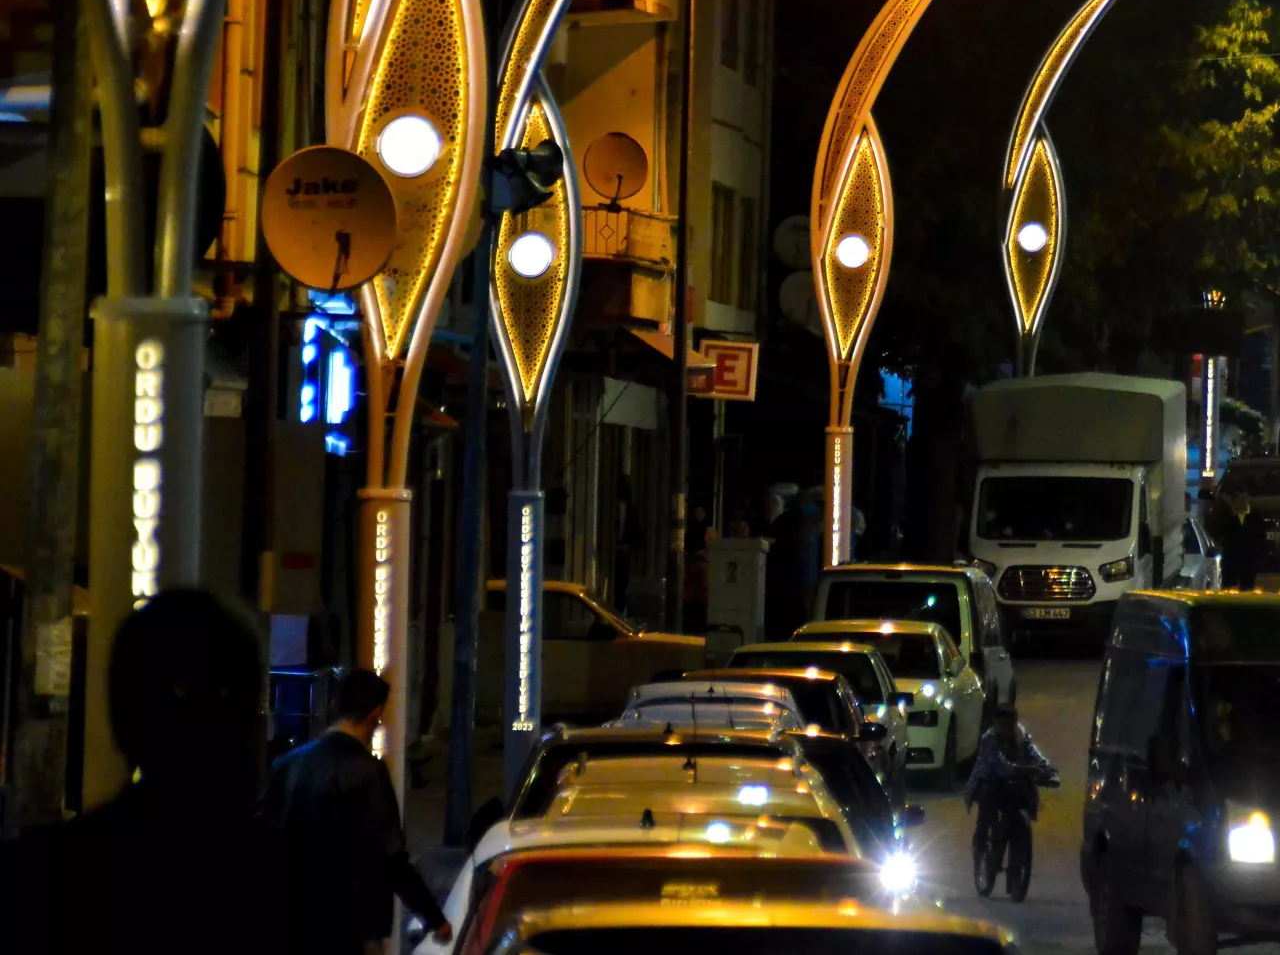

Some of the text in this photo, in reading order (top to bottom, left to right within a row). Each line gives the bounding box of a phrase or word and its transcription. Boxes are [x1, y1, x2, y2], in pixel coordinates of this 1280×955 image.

[286, 177, 358, 195] Jake
[715, 352, 739, 387] E
[134, 340, 163, 452] ORDU
[834, 437, 842, 464] ORDU
[376, 510, 388, 562] ORDU
[521, 506, 531, 543] ORDU
[512, 723, 534, 731] 2023
